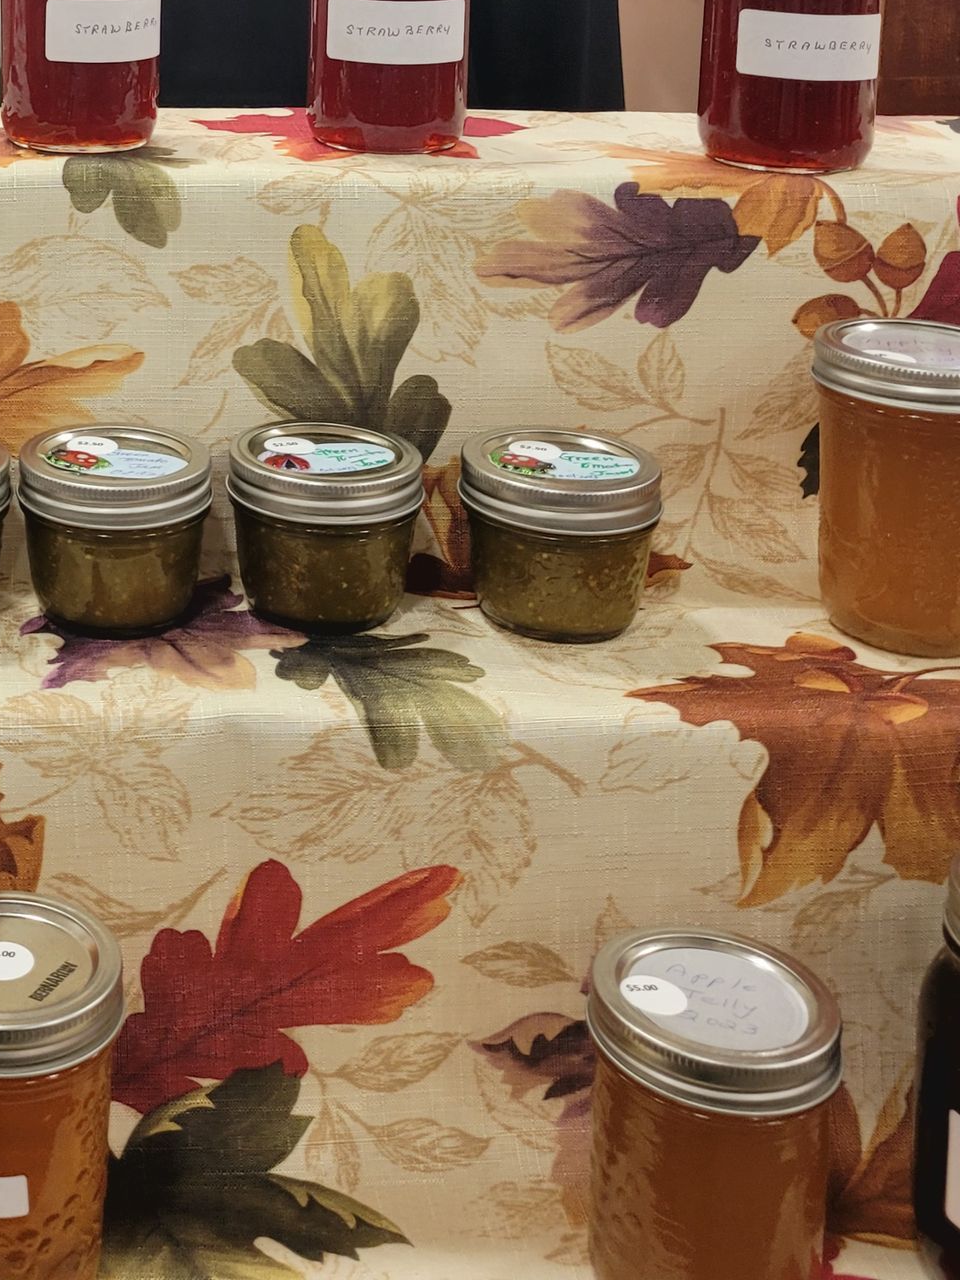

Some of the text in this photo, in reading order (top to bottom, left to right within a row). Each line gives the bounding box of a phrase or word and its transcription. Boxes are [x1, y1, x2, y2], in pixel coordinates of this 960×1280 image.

[764, 38, 872, 54] STRAWBERRY
[665, 964, 758, 992] Apple
[625, 984, 659, 993] $5.00
